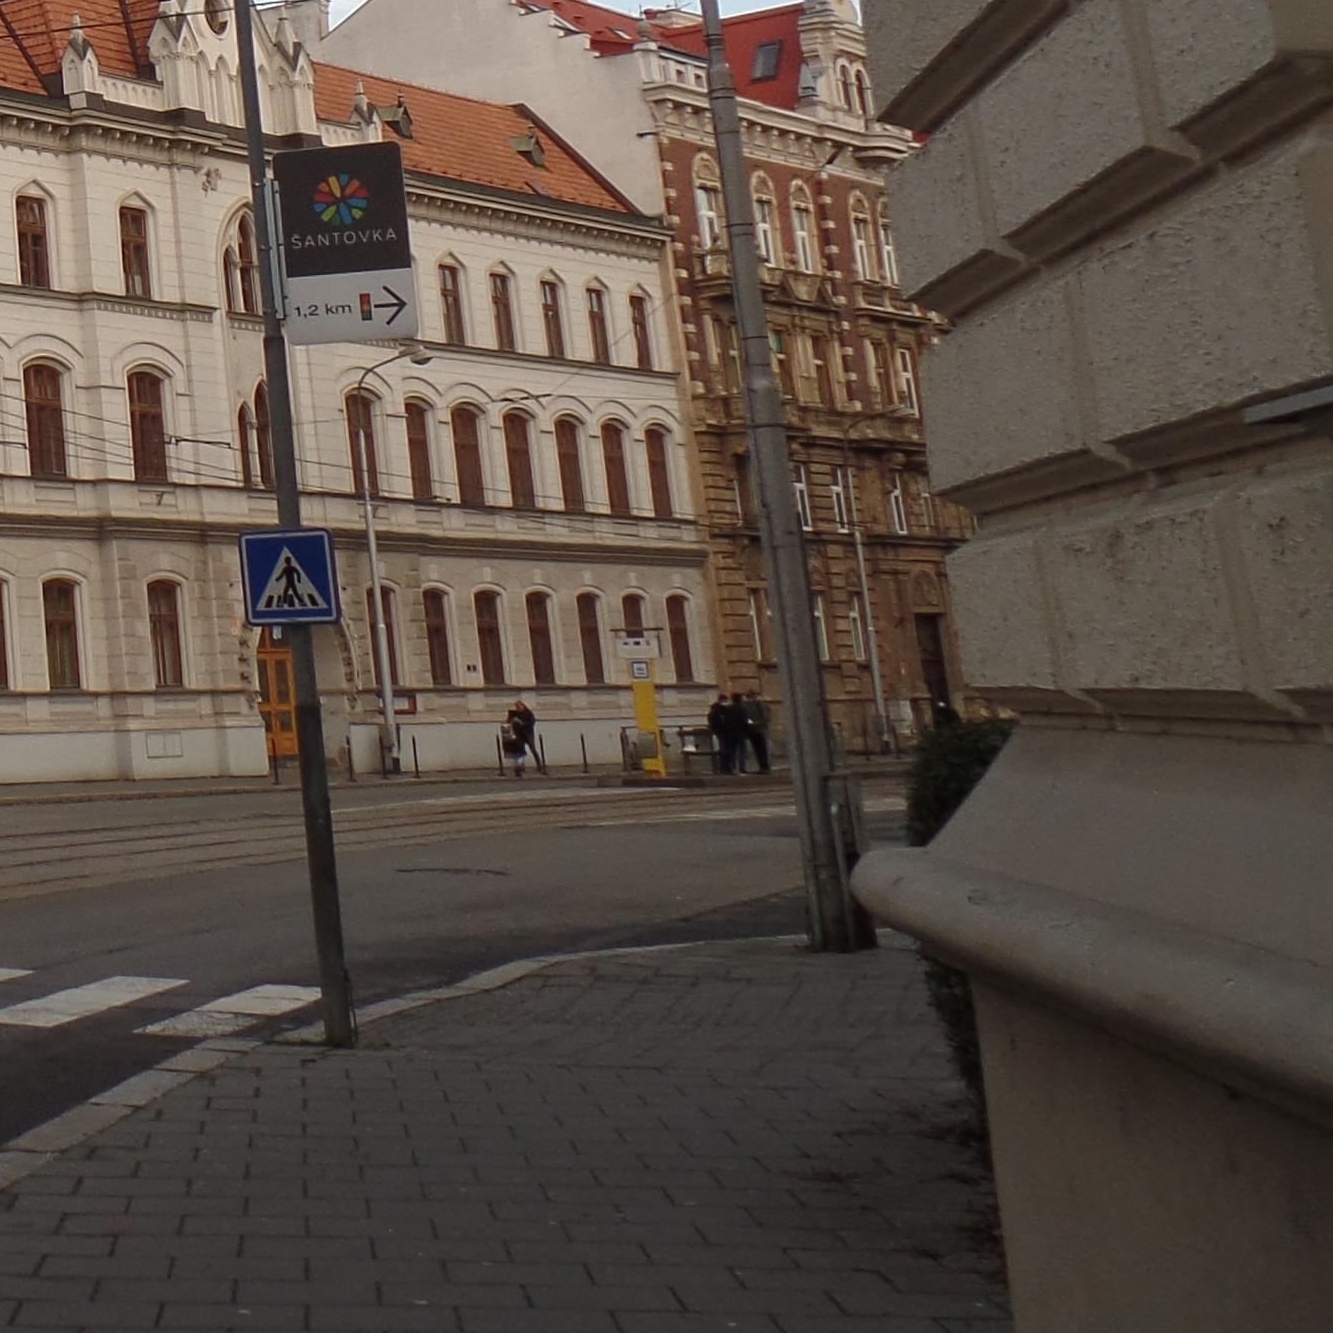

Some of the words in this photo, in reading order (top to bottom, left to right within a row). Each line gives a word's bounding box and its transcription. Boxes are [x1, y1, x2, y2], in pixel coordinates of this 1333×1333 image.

[290, 227, 398, 250] ŠANTOVKA
[294, 303, 320, 319] 1,2
[325, 301, 352, 316] km
